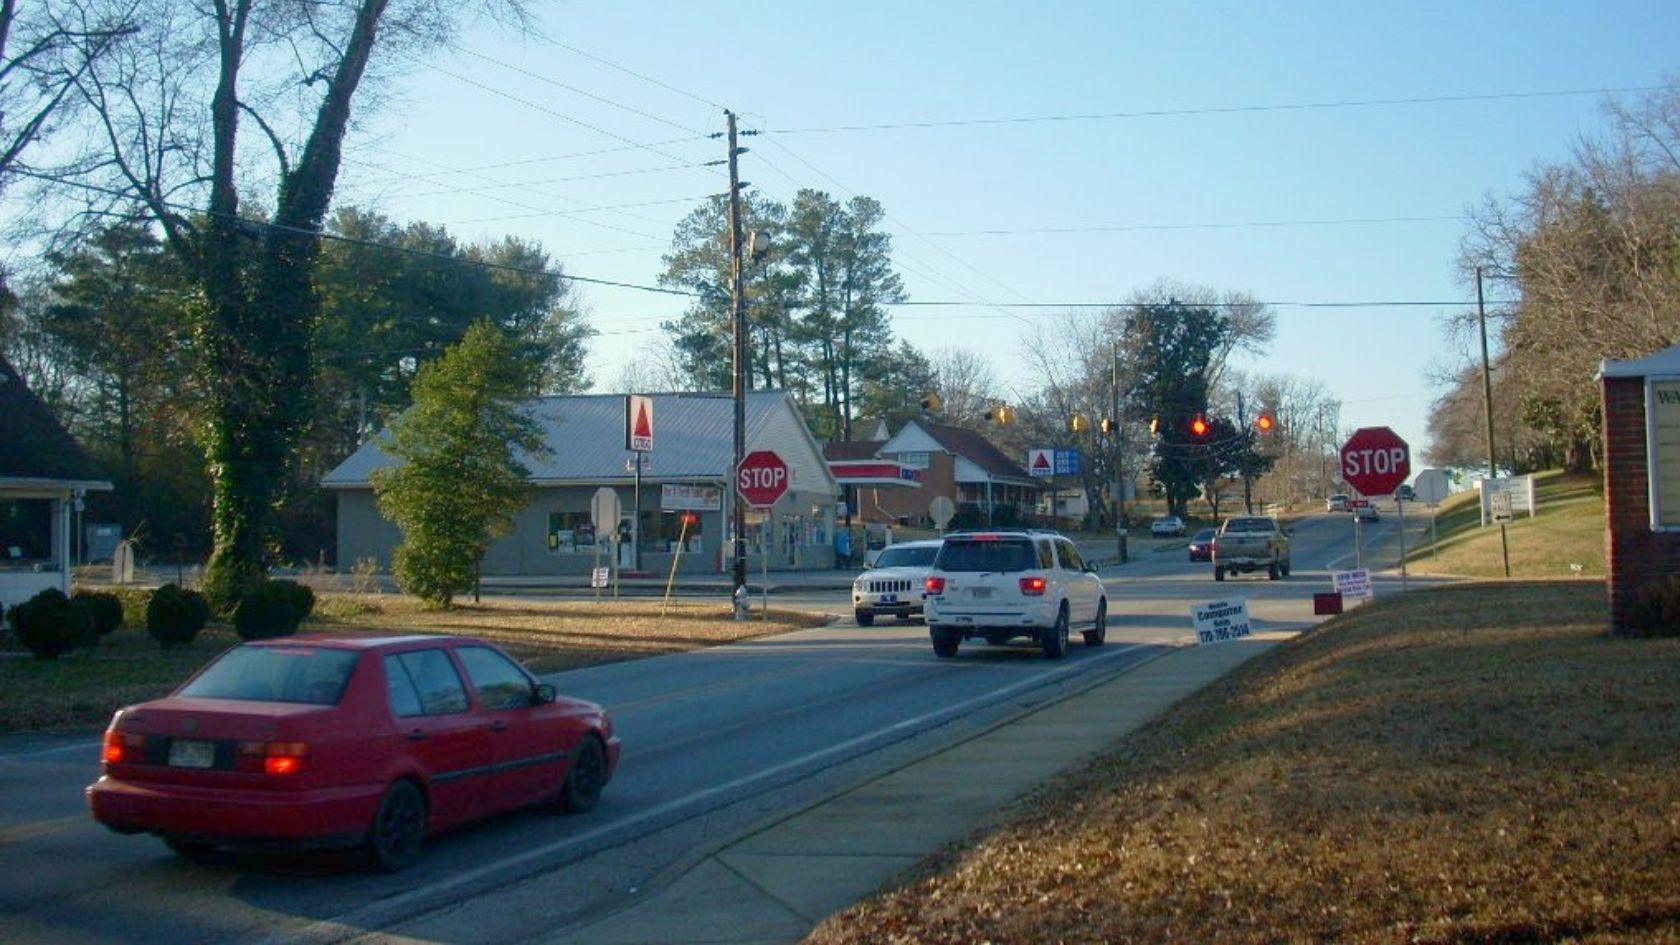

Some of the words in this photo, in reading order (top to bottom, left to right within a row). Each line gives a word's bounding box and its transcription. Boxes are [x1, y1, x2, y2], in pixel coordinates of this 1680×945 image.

[1345, 447, 1405, 477] STOP
[740, 467, 786, 489] STOP
[1197, 605, 1243, 621] Computer
